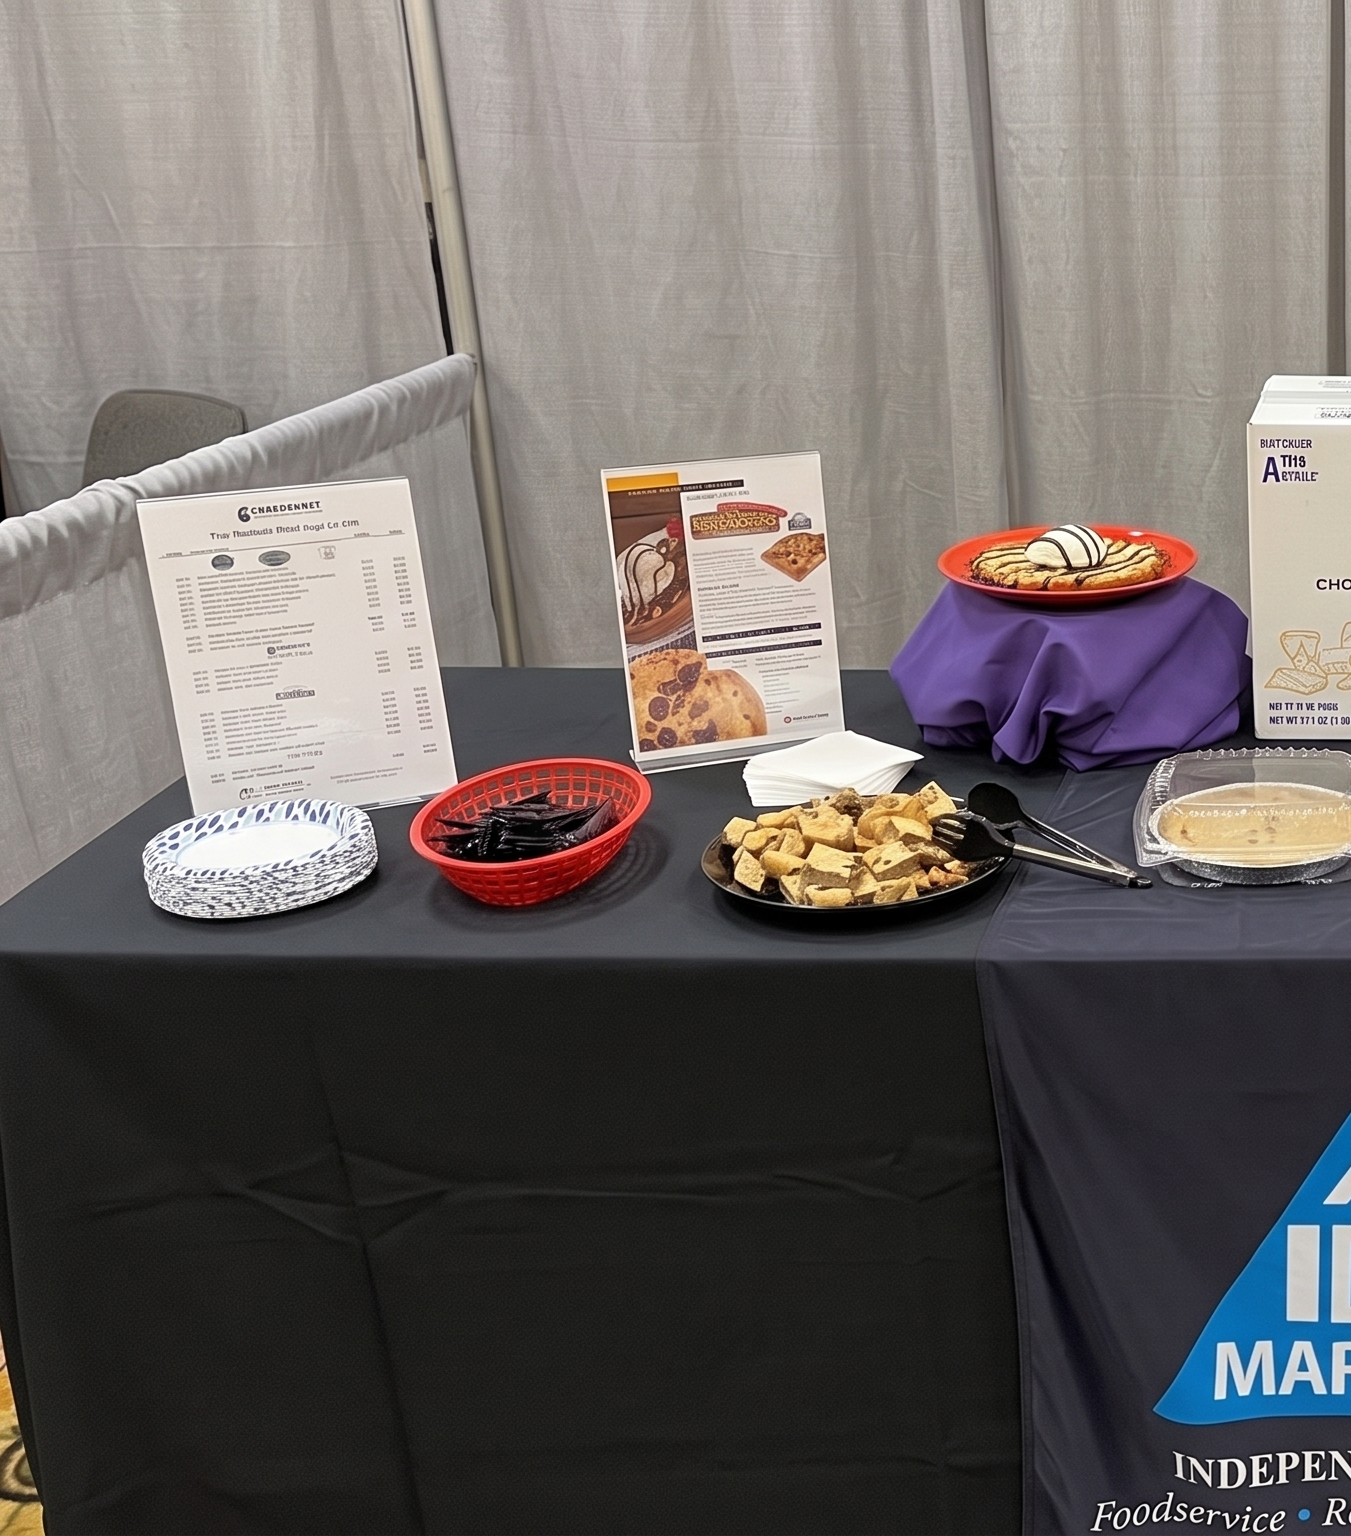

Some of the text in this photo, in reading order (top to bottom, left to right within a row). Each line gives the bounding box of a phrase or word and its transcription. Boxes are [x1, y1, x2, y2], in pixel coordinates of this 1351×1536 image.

[1269, 716, 1284, 725] NET
[1285, 716, 1298, 725] WT
[1090, 1492, 1286, 1533] Foodservice
